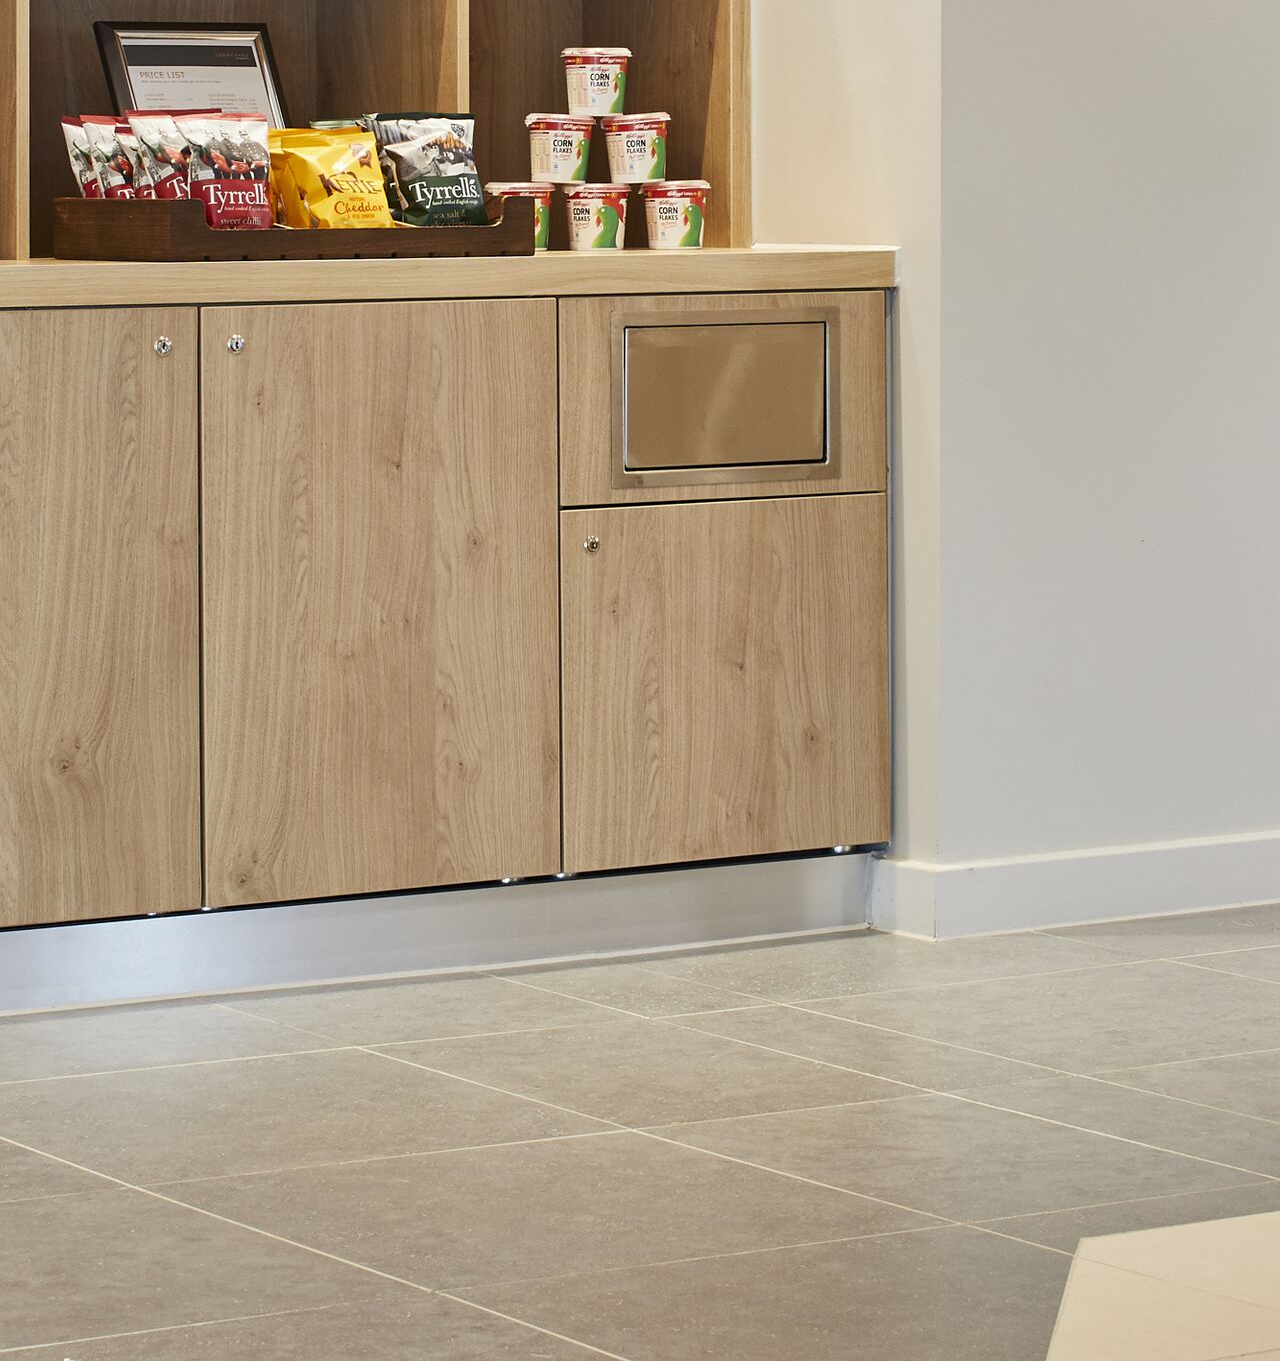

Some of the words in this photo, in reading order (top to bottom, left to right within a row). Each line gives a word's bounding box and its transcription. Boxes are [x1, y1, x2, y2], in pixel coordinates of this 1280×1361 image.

[139, 71, 165, 79] PRICE
[166, 71, 186, 79] LIST
[590, 73, 610, 81] CORN
[553, 139, 573, 147] CORN
[626, 139, 646, 148] CORN
[334, 201, 384, 215] Cheddar
[573, 208, 590, 216] CORN
[659, 206, 678, 215] CORN
